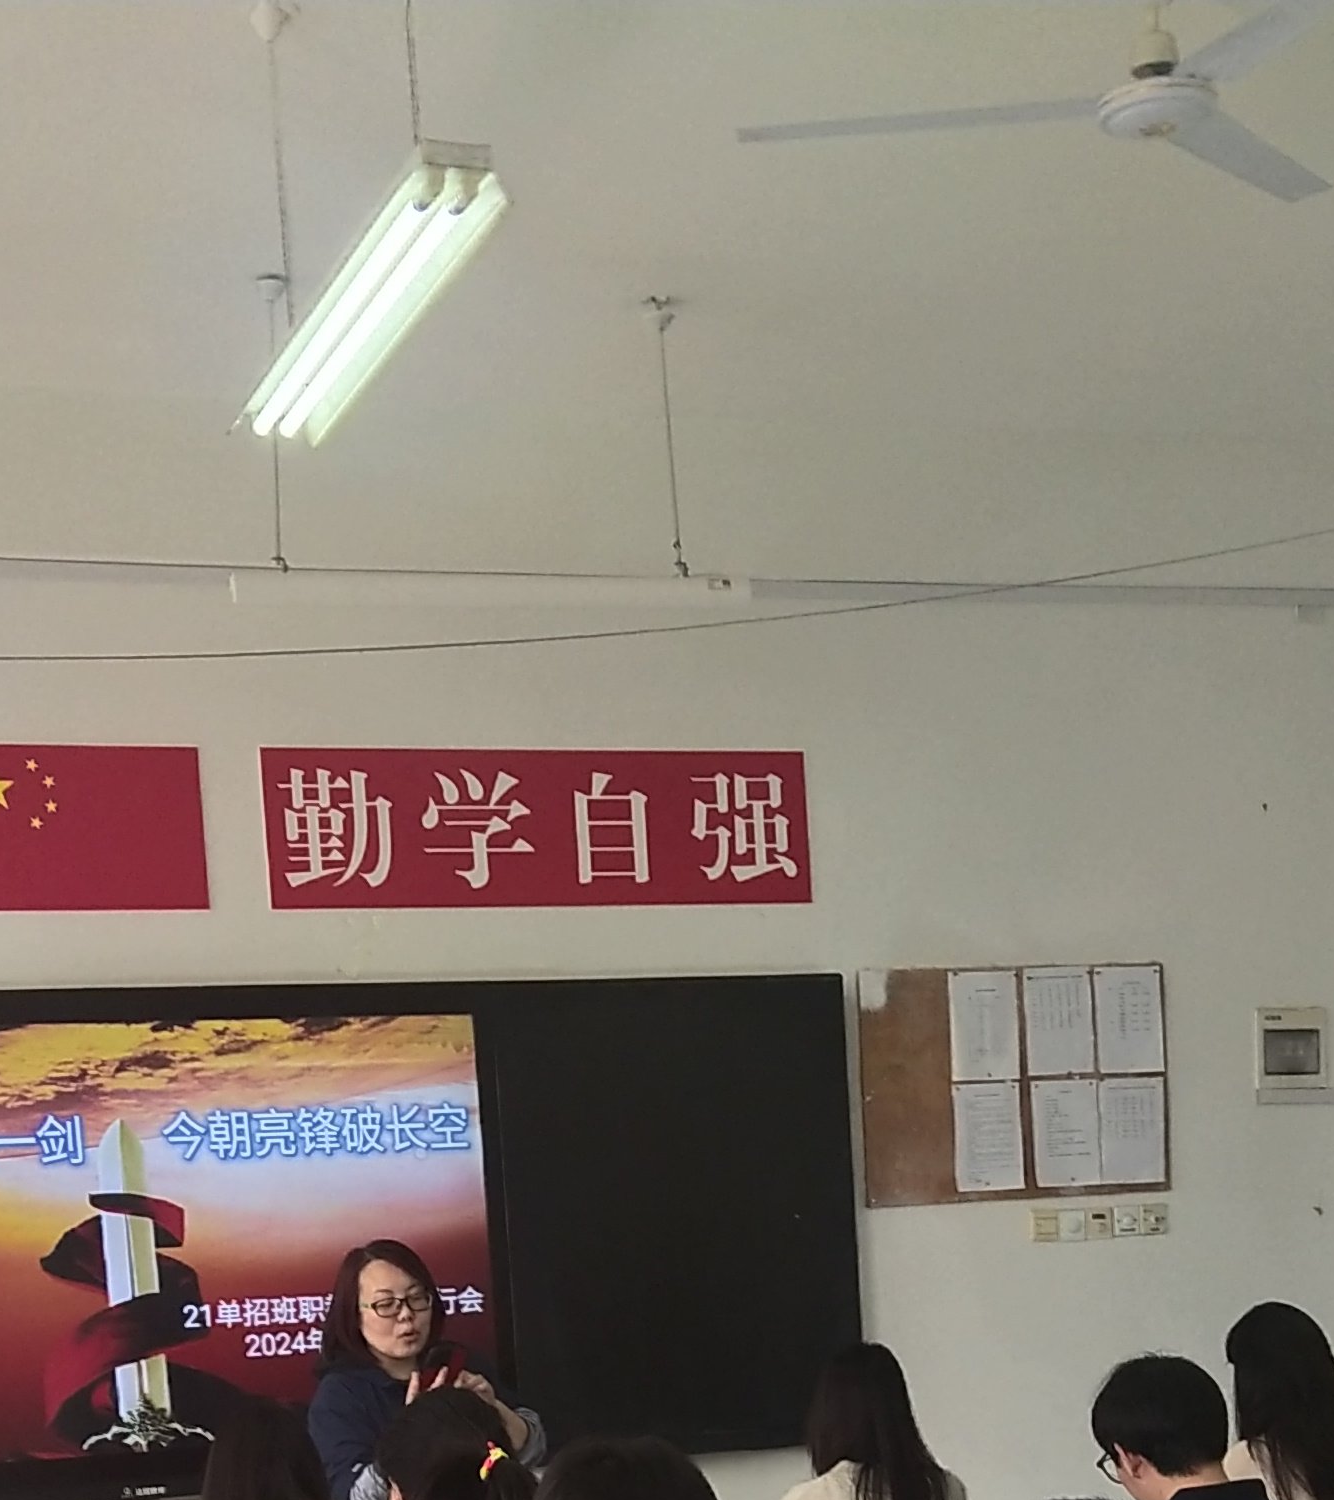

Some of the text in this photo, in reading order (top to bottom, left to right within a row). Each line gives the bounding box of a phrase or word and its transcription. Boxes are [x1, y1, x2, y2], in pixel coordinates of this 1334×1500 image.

[276, 767, 799, 889] 勤学自强
[162, 1102, 470, 1160] 今朝亮锋破长空
[182, 1293, 334, 1329] 21单招班职
